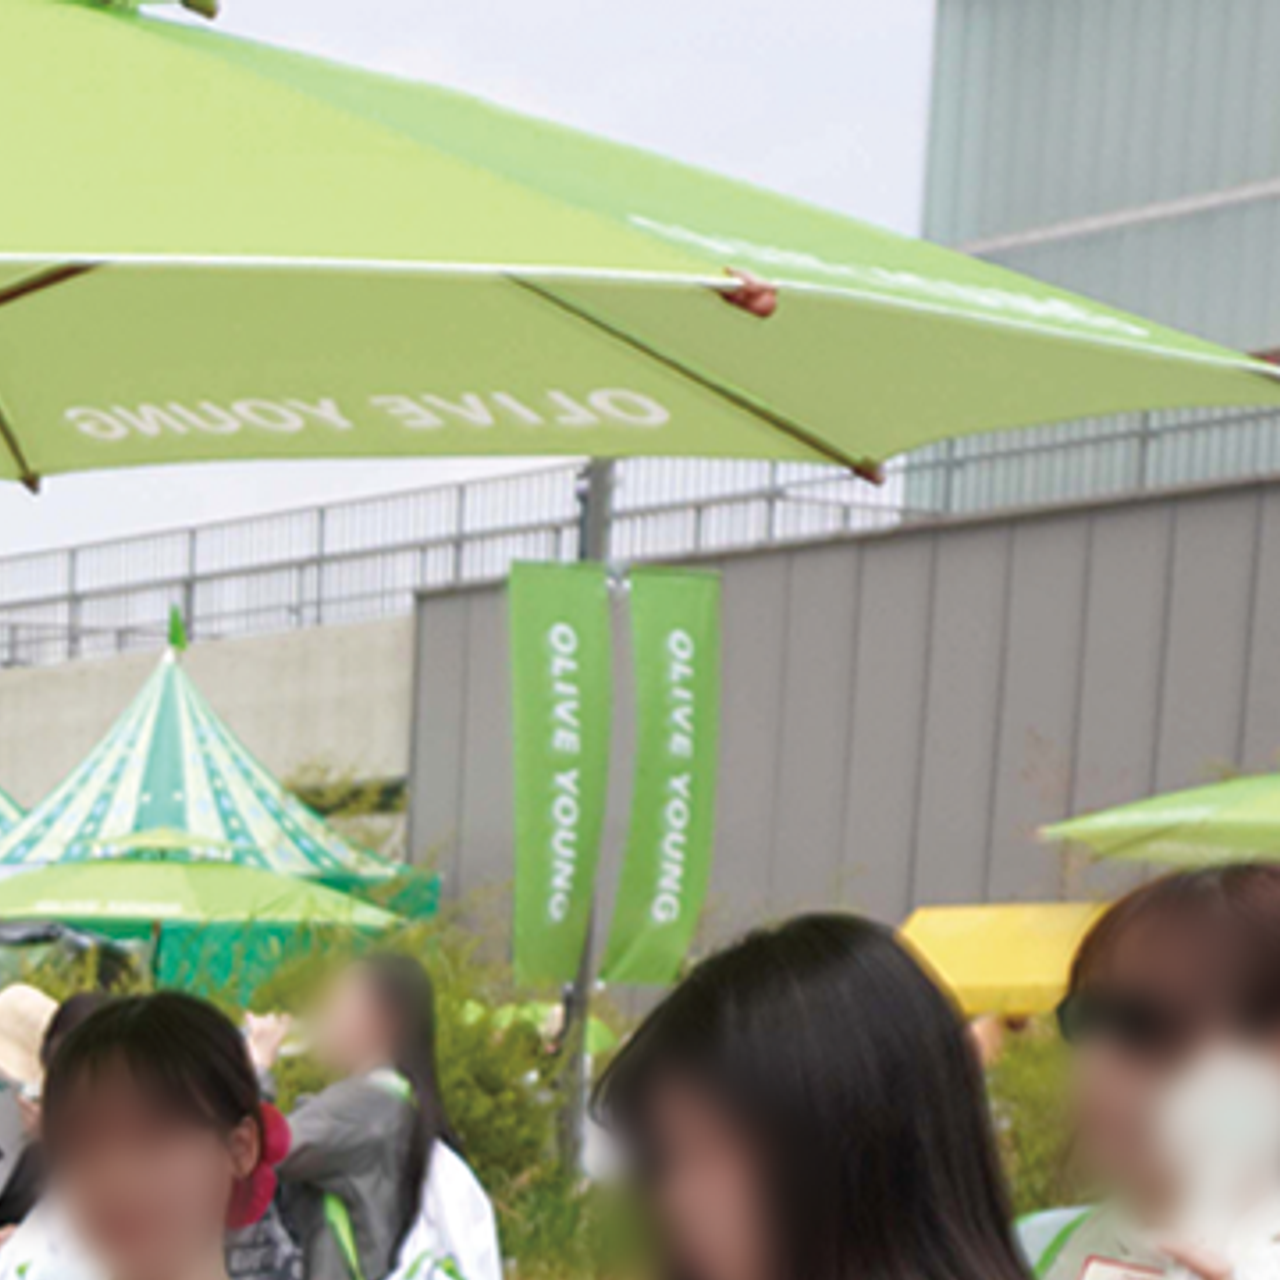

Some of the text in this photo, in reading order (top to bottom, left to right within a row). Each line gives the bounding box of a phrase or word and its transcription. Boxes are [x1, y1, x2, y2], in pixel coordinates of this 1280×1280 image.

[548, 622, 581, 923] OLIVE YOUNG
[652, 628, 695, 923] OLIVE YOUNG
